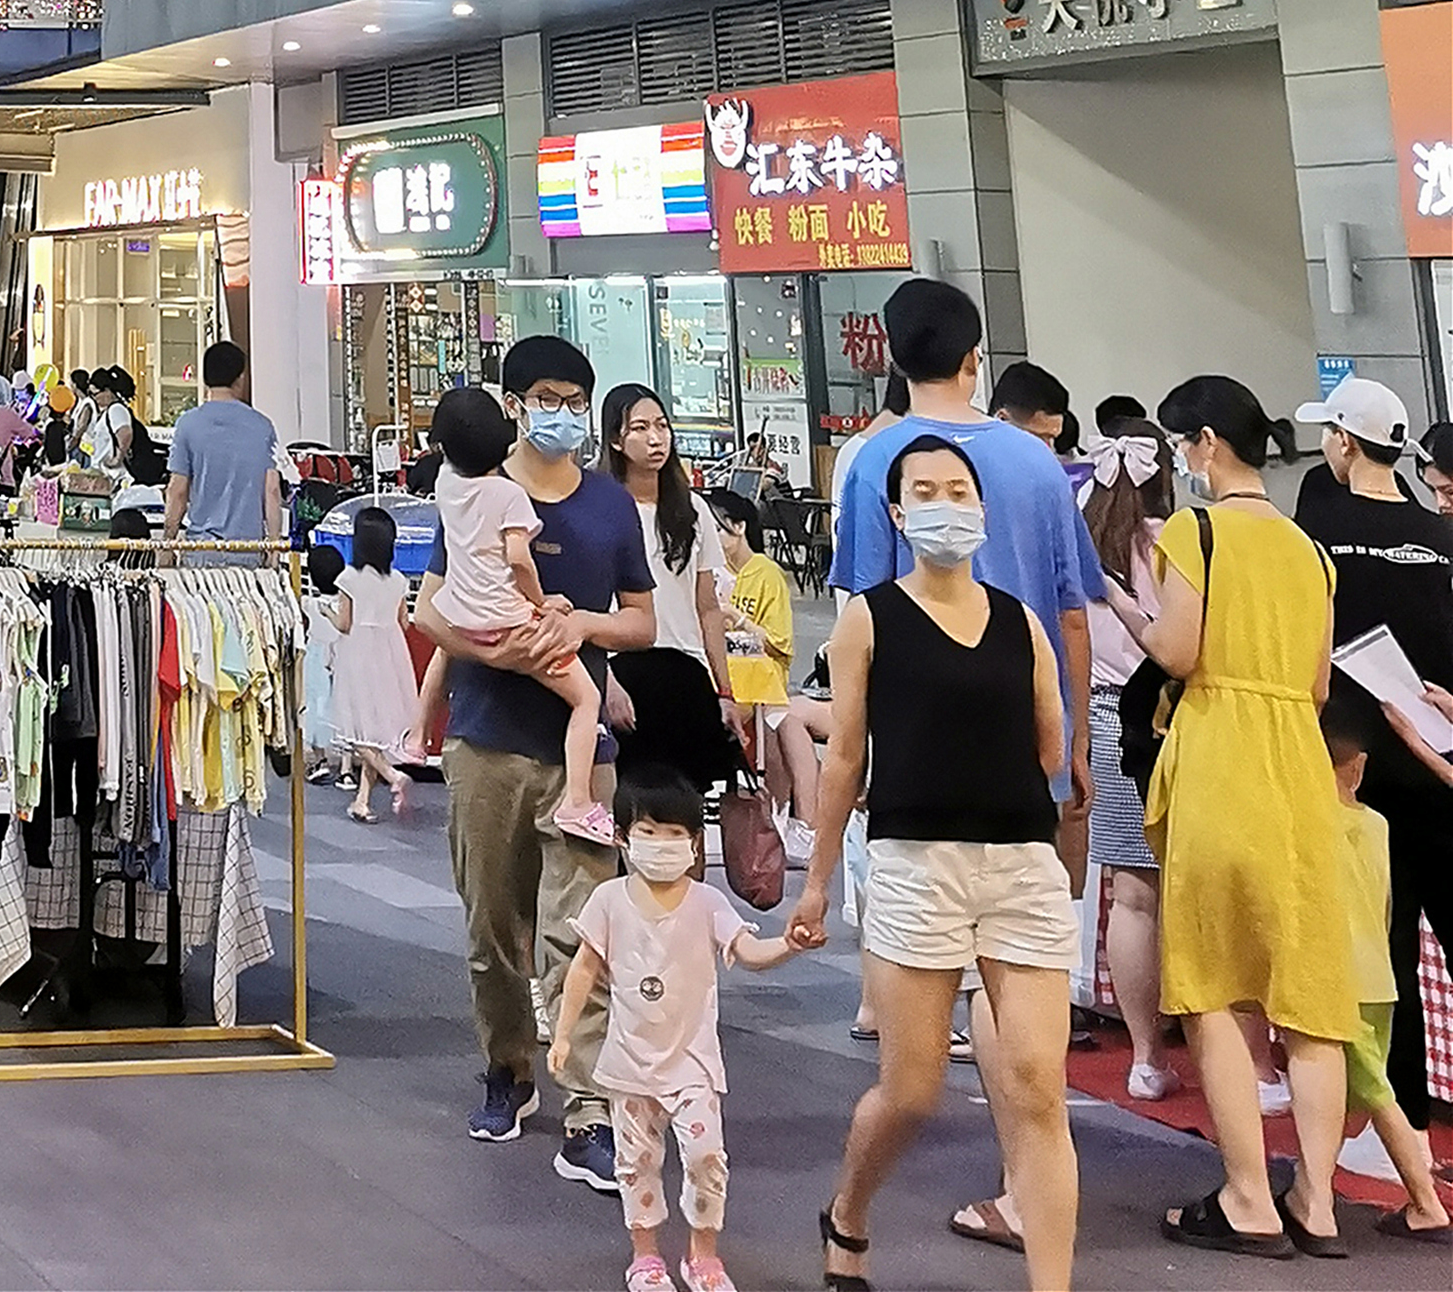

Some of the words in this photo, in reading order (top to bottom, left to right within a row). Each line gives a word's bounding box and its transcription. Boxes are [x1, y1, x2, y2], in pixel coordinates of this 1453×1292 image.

[746, 131, 898, 196] 汇东牛杂
[734, 207, 774, 246] 快餐
[788, 203, 830, 242] 粉面
[847, 199, 891, 240] 小吃
